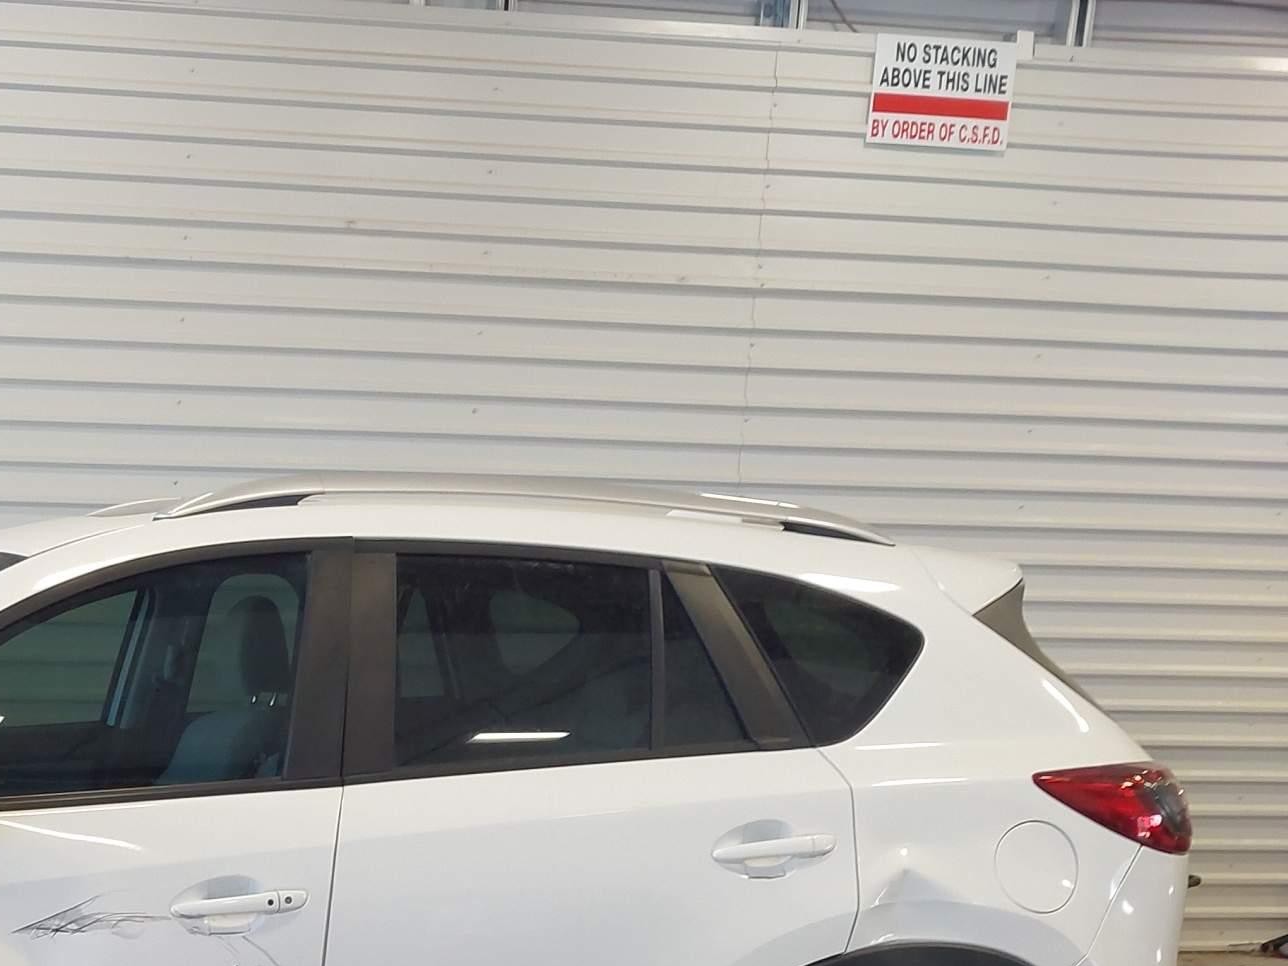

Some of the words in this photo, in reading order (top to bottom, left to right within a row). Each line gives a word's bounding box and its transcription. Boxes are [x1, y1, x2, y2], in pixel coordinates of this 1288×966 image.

[896, 42, 917, 63] NO
[922, 44, 998, 69] STACKING
[880, 67, 932, 89] ABOVE
[937, 71, 969, 92] THIS
[974, 73, 1008, 95] LINE
[871, 119, 889, 138] BY
[892, 120, 935, 141] ORDER
[939, 123, 956, 141] OF
[959, 124, 1003, 145] C.S.F.D.
